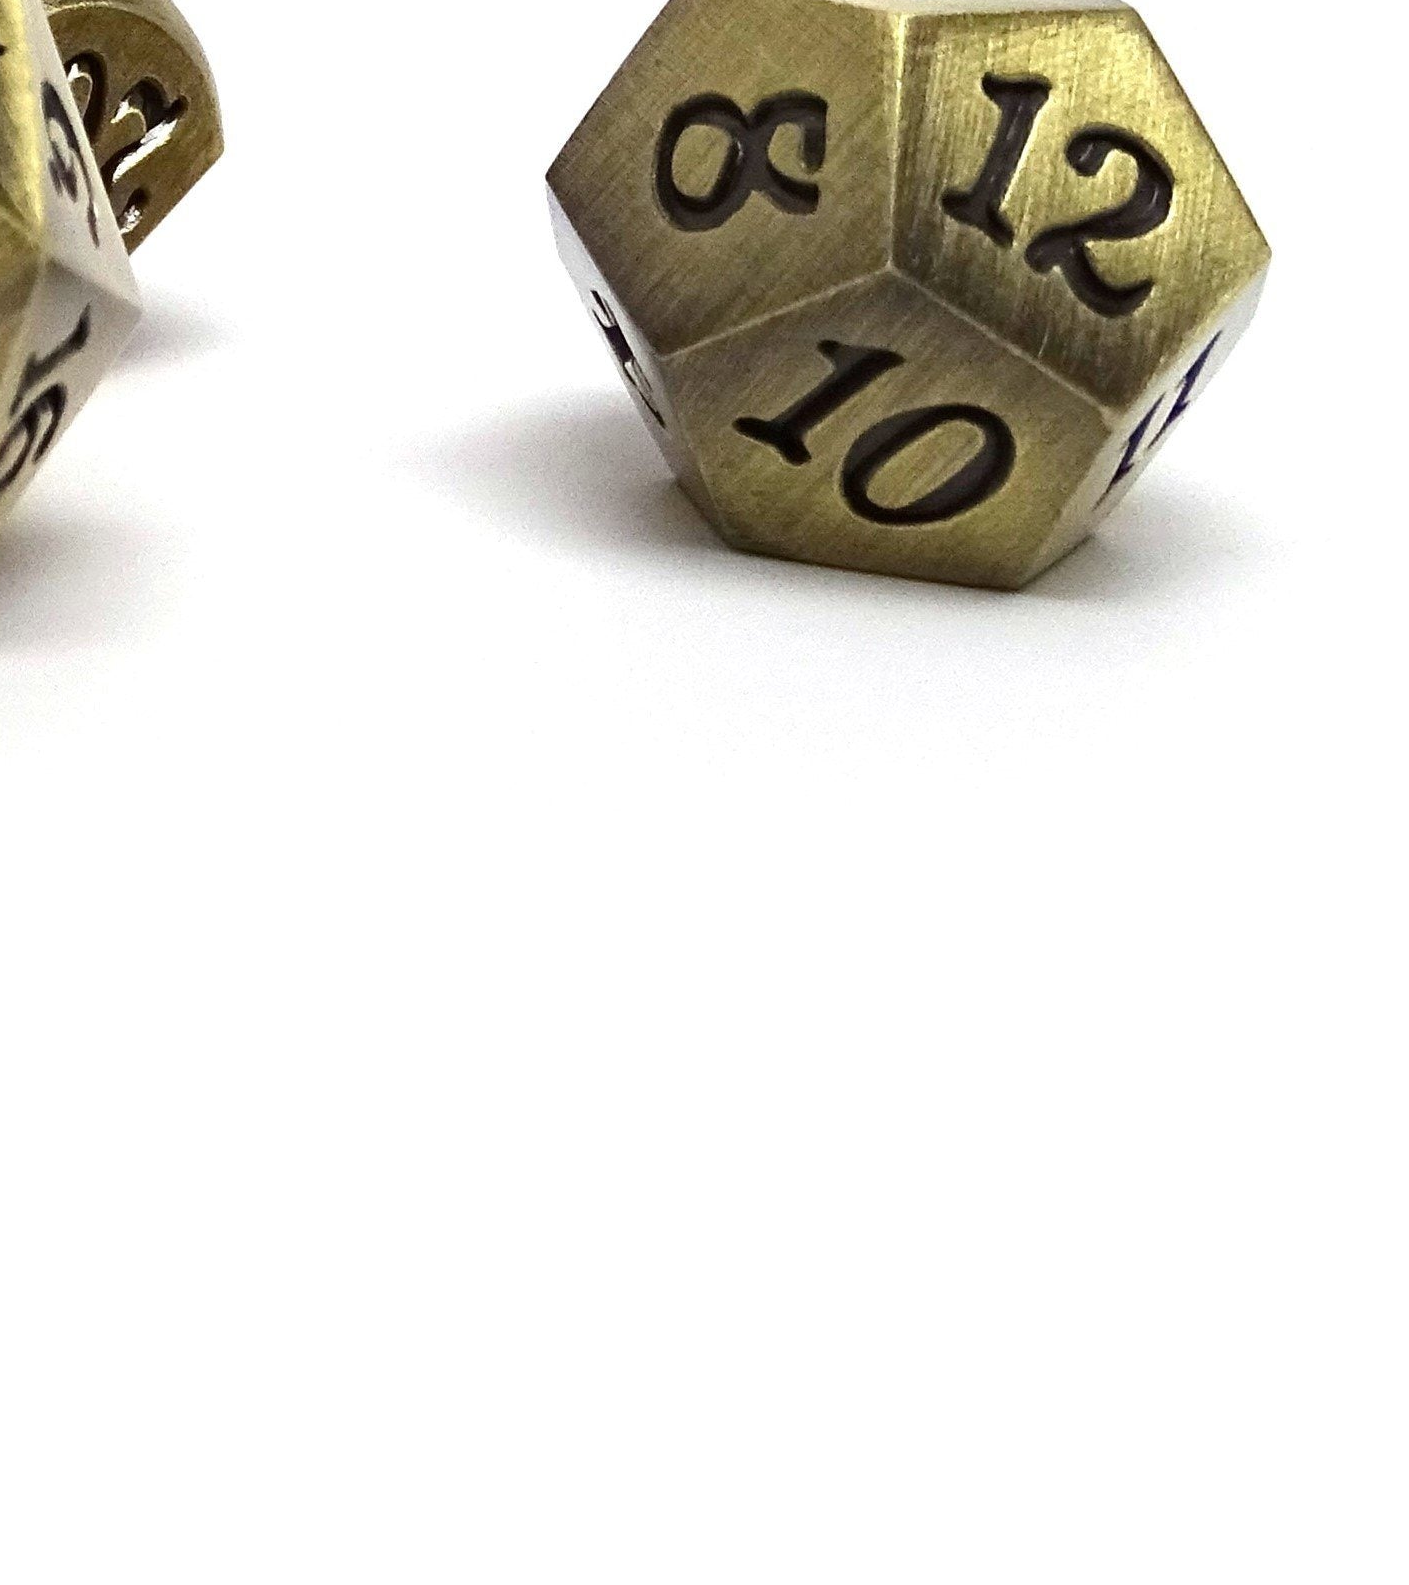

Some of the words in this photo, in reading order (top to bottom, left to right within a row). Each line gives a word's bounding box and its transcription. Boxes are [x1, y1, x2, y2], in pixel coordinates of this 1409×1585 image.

[652, 89, 830, 233] 8
[941, 71, 1175, 319] 12
[732, 339, 1018, 528] 10
